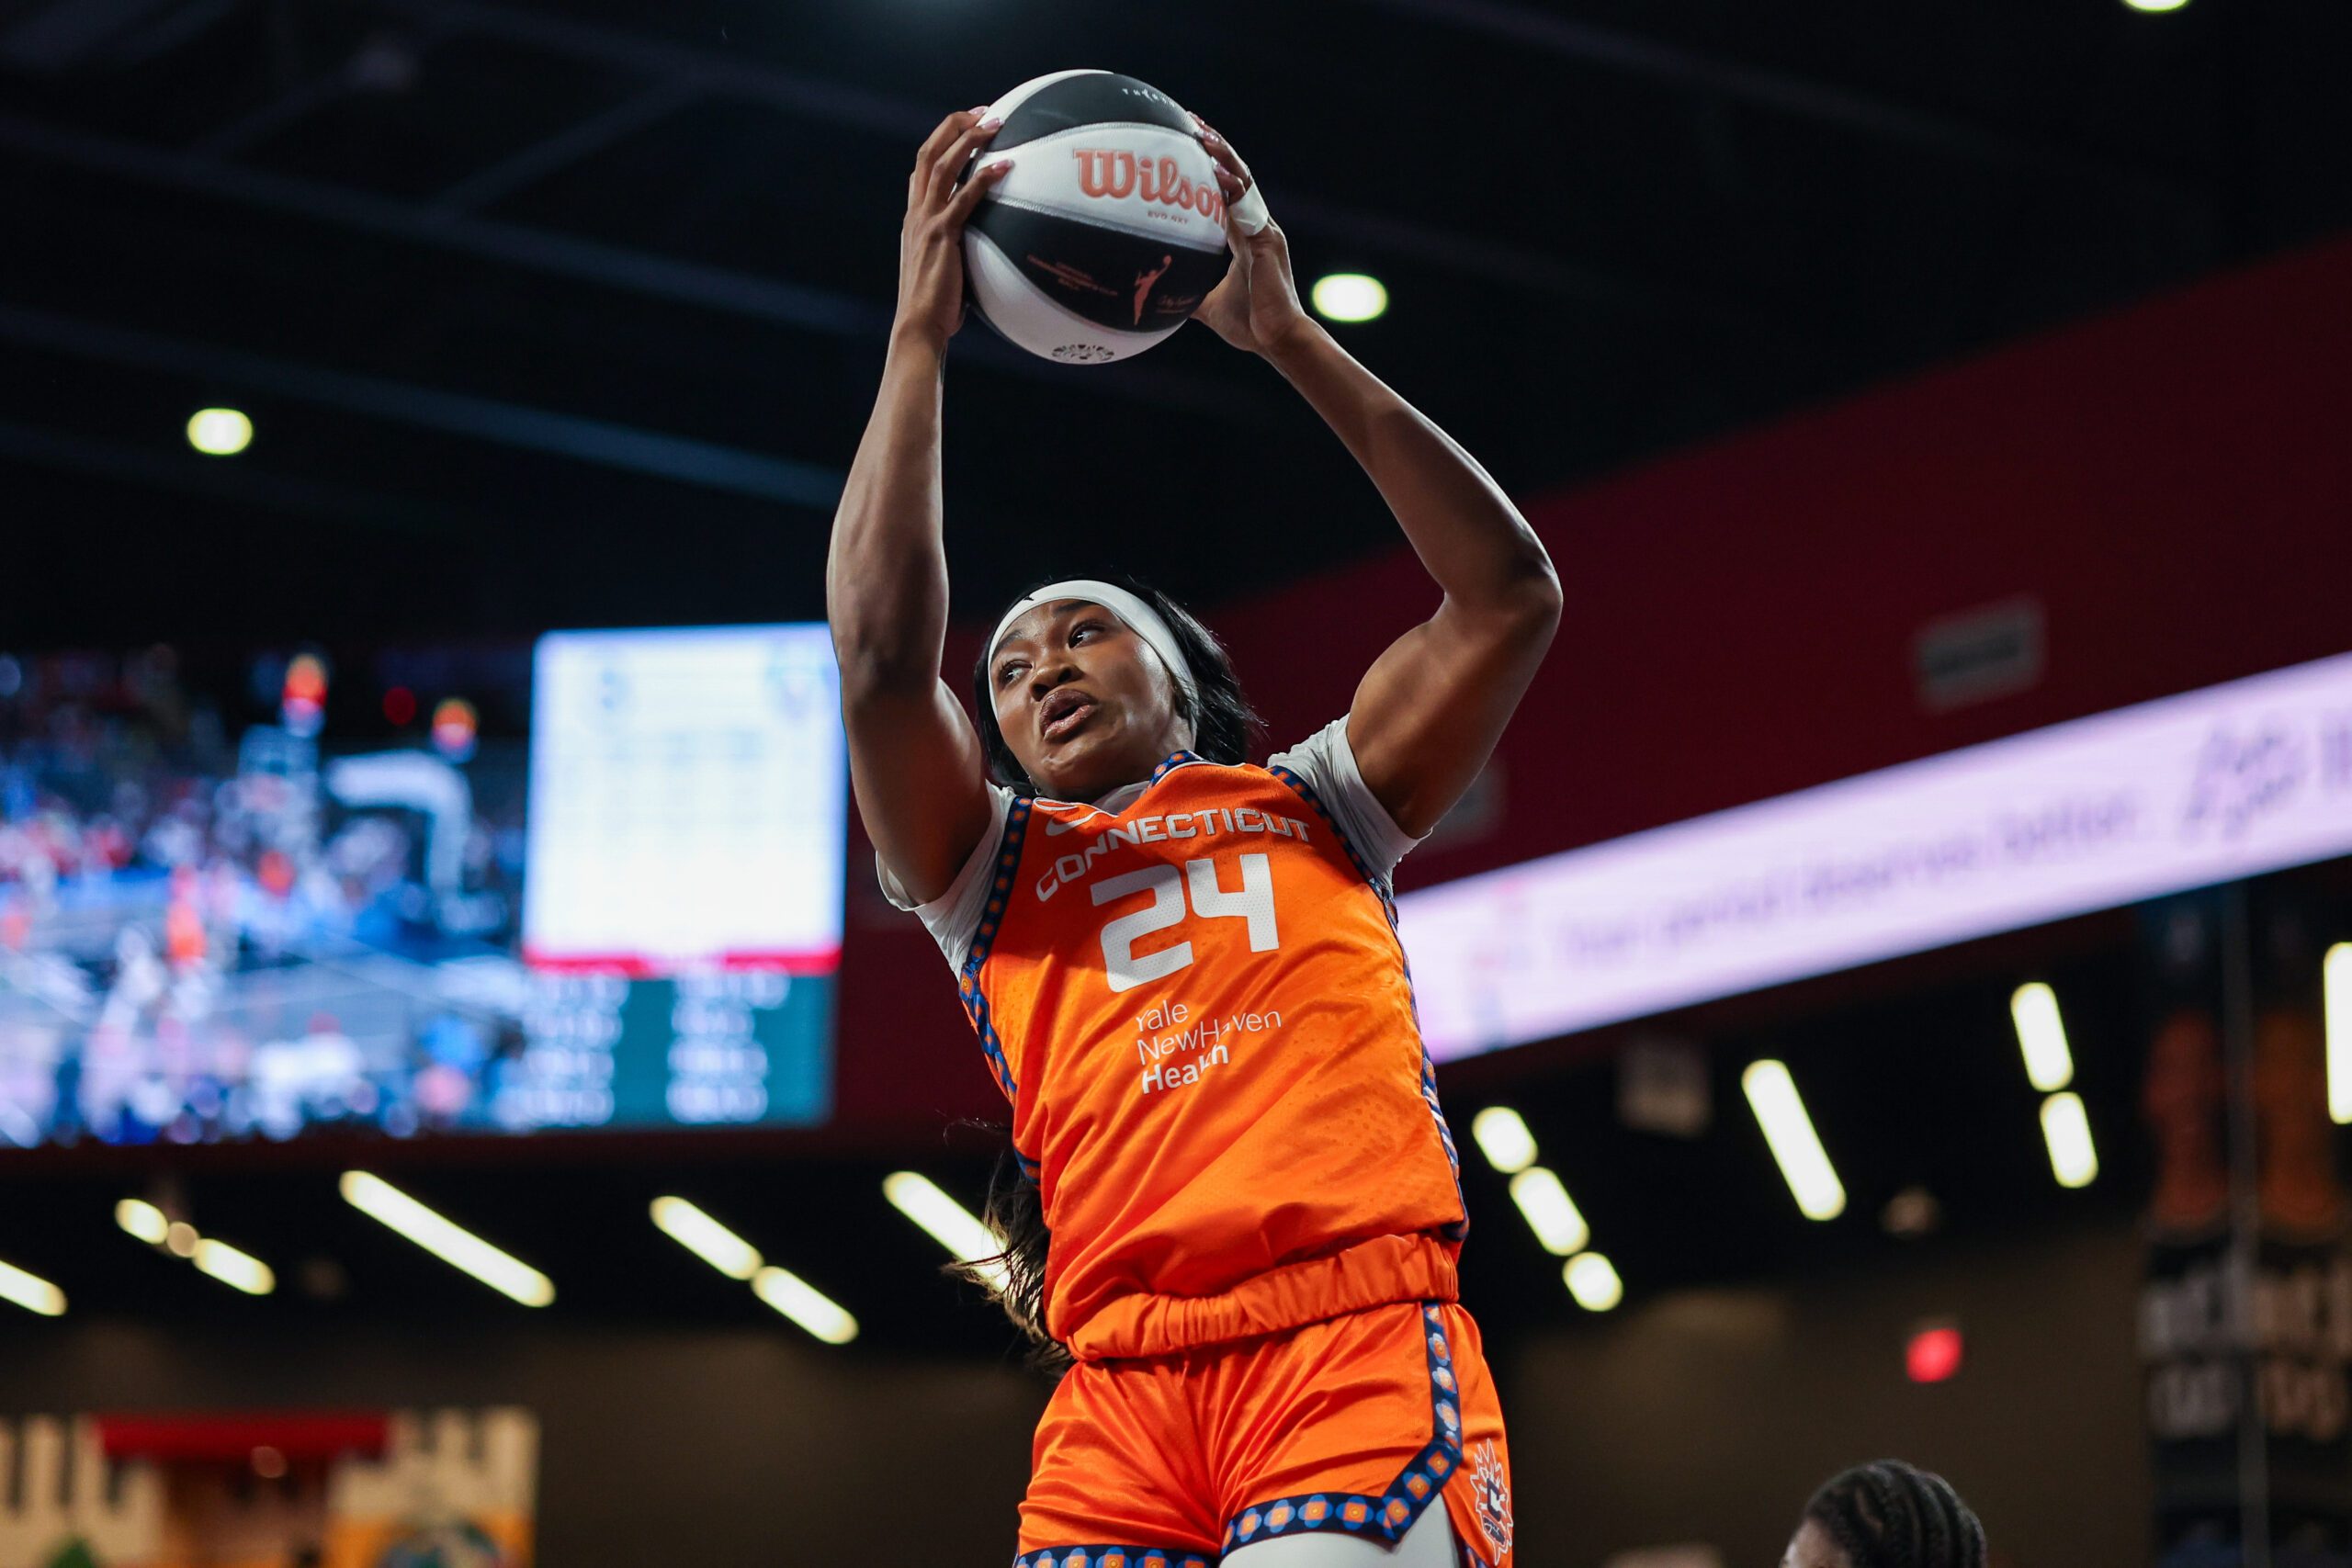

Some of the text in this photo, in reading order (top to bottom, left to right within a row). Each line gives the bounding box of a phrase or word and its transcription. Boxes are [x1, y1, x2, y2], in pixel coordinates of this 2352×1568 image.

[1073, 149, 1227, 226] Wilson
[1035, 807, 1309, 902] CONNECTICUT
[1090, 853, 1280, 993] 24
